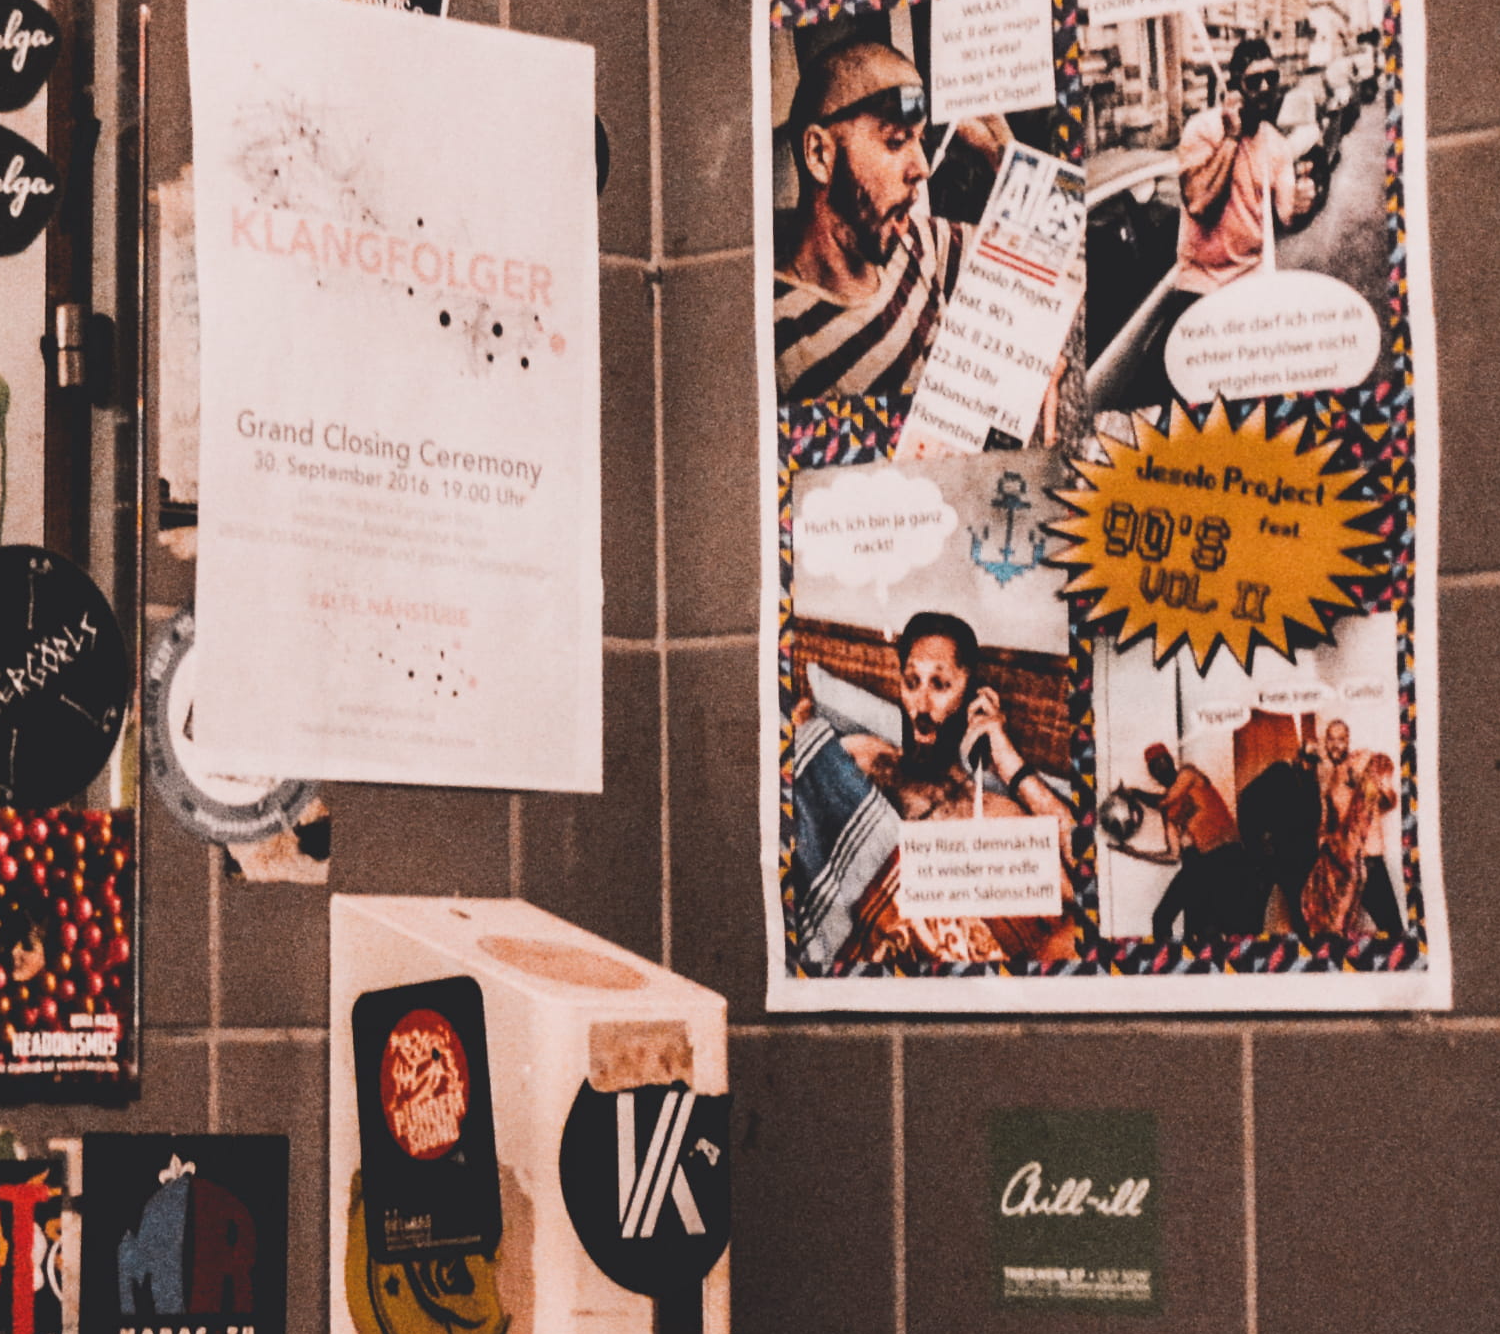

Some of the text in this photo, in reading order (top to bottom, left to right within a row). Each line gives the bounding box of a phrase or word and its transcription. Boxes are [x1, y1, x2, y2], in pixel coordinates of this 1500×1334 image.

[230, 206, 554, 307] KLANGFOLGER
[237, 410, 543, 489] Grand Closing Ceremony
[287, 456, 383, 492] September
[387, 472, 430, 496] 2016
[443, 479, 490, 504] 19.00
[496, 484, 527, 508] Uhr
[1223, 466, 1324, 506] Project
